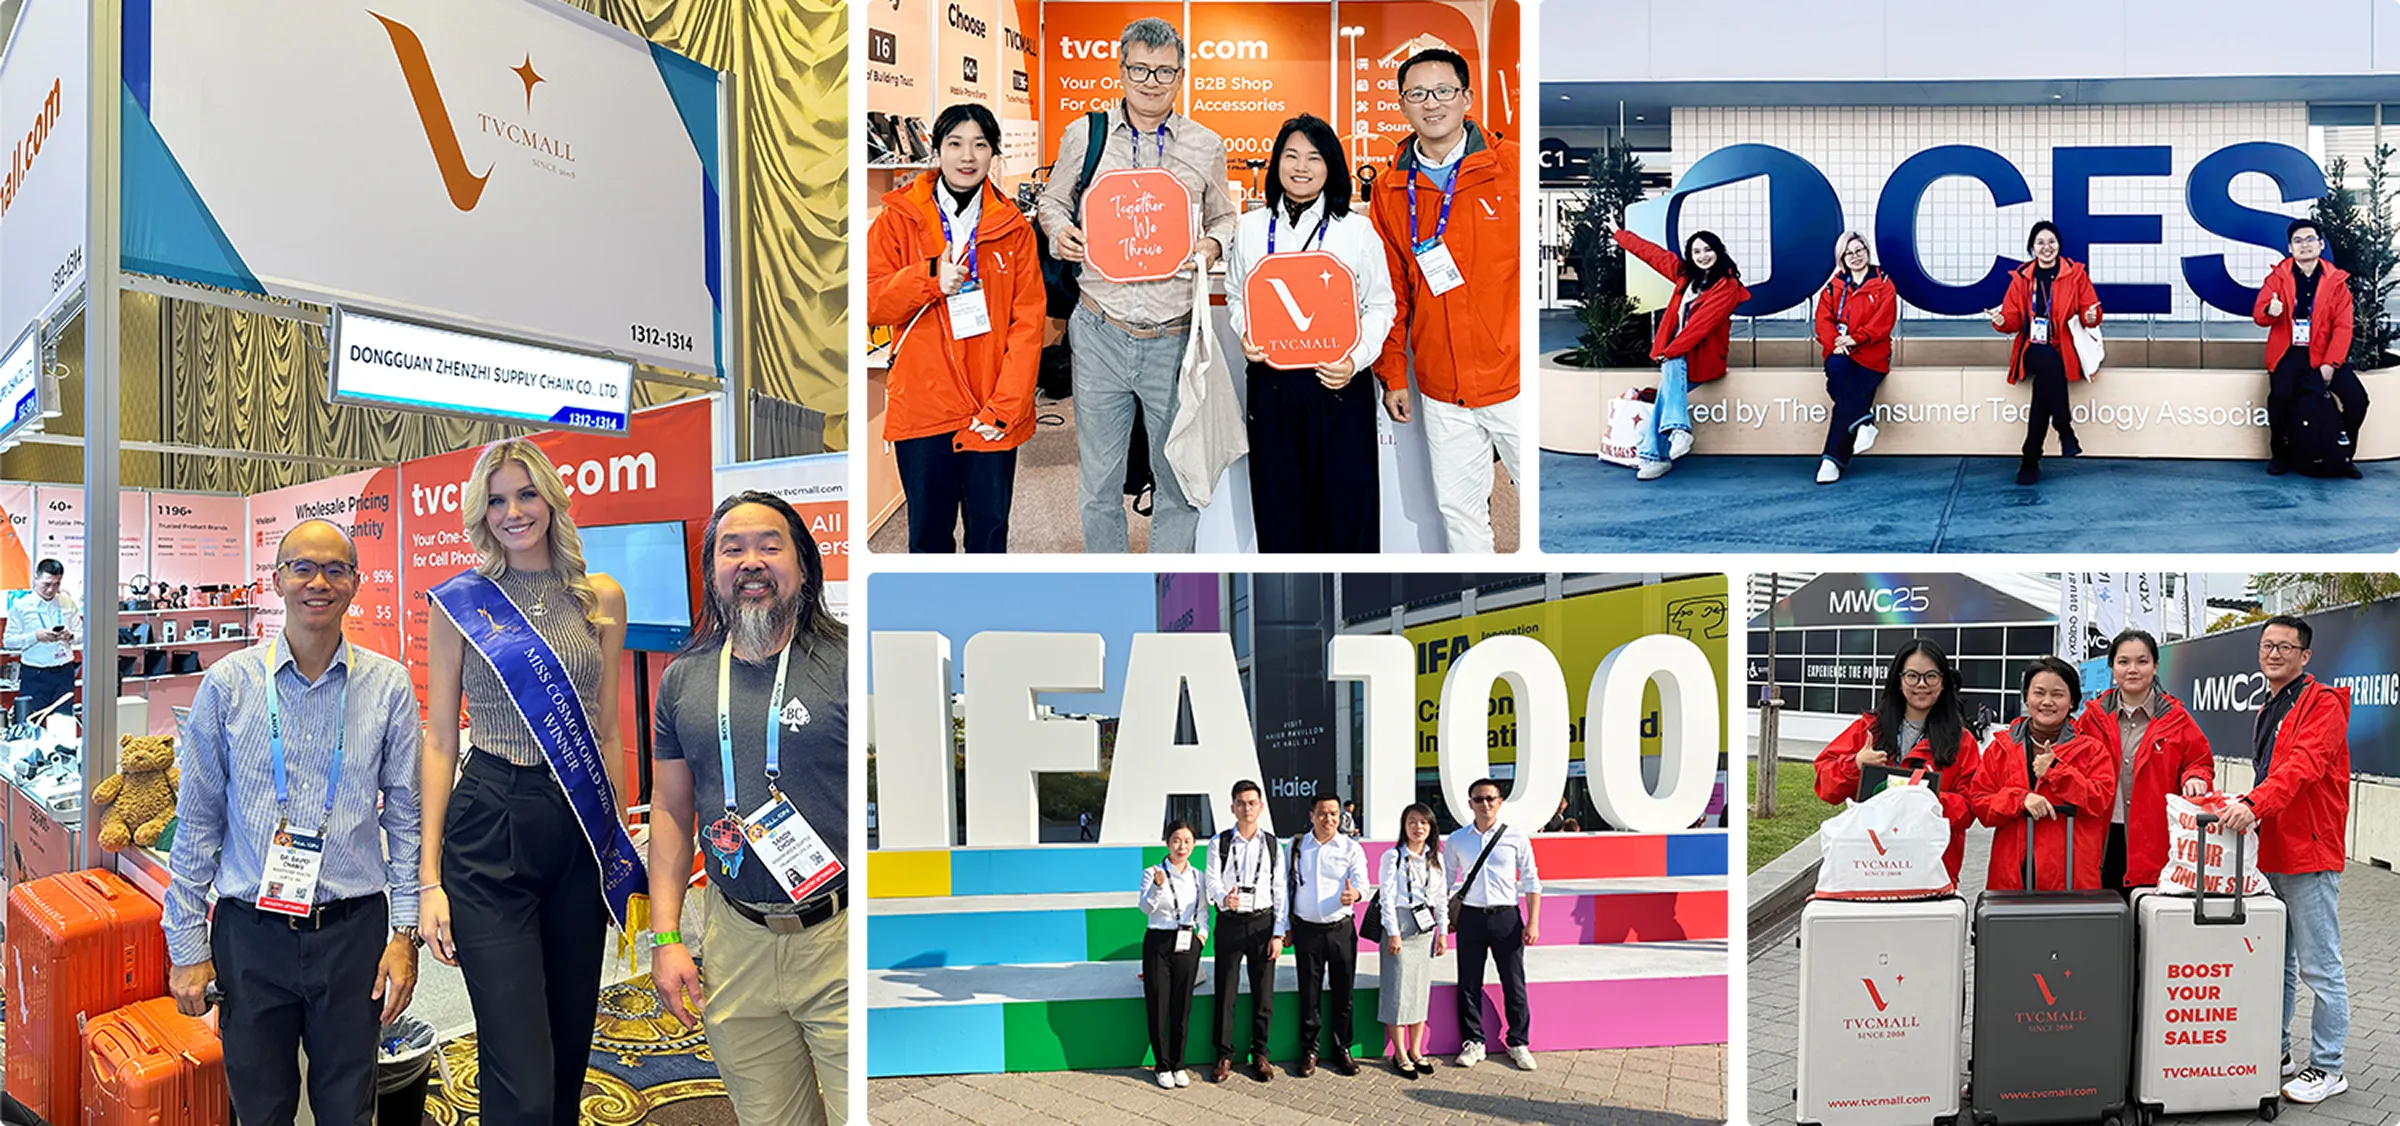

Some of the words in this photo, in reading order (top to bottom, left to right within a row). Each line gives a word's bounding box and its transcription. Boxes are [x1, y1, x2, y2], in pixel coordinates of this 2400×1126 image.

[948, 3, 987, 39] Choose
[1004, 27, 1038, 57] TVCMALL
[874, 35, 891, 59] 16
[1059, 36, 1269, 60] tvc.com
[873, 70, 899, 87] Building
[1059, 77, 1096, 89] Your
[1194, 77, 1226, 90] B2B
[1231, 76, 1273, 93] Shop
[1060, 97, 1086, 111] For
[1193, 98, 1286, 112] Accessories
[1377, 101, 1401, 111] Dro
[1377, 121, 1415, 132] Sourc
[477, 113, 576, 163] TVCMALL
[532, 158, 557, 174] SINCE
[1539, 150, 1565, 168] C1
[1110, 192, 1166, 220] Together
[1133, 215, 1158, 241] We
[1875, 141, 2334, 319] CES
[1118, 237, 1164, 262] Thrive
[630, 324, 694, 352] 1312-1314
[1268, 336, 1341, 352] TVCMALL
[350, 345, 433, 373] DONGGUAN
[436, 357, 491, 382] ZHENZHI
[493, 366, 538, 389] SUPPLY
[539, 374, 575, 394] CHAIN
[568, 412, 617, 430] 1312-1314
[1687, 399, 1727, 423] red
[1736, 399, 1769, 430] by
[1773, 398, 1827, 423] The
[1871, 402, 1981, 424] nsumer
[1986, 397, 2151, 430] Tecology
[2156, 400, 2270, 427] Associa
[48, 500, 73, 512] 40+
[158, 504, 192, 517] 1196+
[295, 498, 345, 520] Wholesale
[348, 492, 389, 512] Pricing
[9, 513, 28, 525] for
[811, 513, 841, 533] All
[412, 533, 435, 547] Your
[437, 530, 471, 544] One-S
[818, 541, 849, 555] ers
[413, 553, 427, 567] for
[429, 551, 448, 566] Cell
[372, 569, 394, 584] 95%
[1829, 586, 1930, 614] MWC25
[1807, 664, 1847, 678] EXPERIENCE
[1849, 665, 1861, 679] THE
[2193, 672, 2272, 712] MWC2
[524, 646, 552, 684] MISS
[547, 682, 601, 786] COSMOWORLD
[271, 711, 279, 739] SONY
[720, 712, 728, 741] SONY
[542, 711, 580, 773] WINNER
[871, 630, 1276, 850] IFA
[1328, 633, 1721, 839] 100
[1271, 776, 1318, 797] Haier
[1853, 860, 1913, 869] TVCMALL
[2168, 963, 2234, 979] BOOST
[2167, 986, 2221, 1001] YOUR
[1843, 1017, 1920, 1030] TVCMALL
[2014, 1009, 2086, 1024] TVCMALL
[2165, 1007, 2238, 1023] ONLINE
[1857, 1031, 1884, 1040] SINCE
[1886, 1030, 1906, 1039] 2008
[2028, 1024, 2053, 1033] SINCE
[2164, 1029, 2227, 1046] SALES
[2162, 1065, 2257, 1079] TVCMALL.COM
[2000, 1086, 2097, 1100] www.tvcmall.com
[1828, 1095, 1931, 1109] www.tvcmall.com
